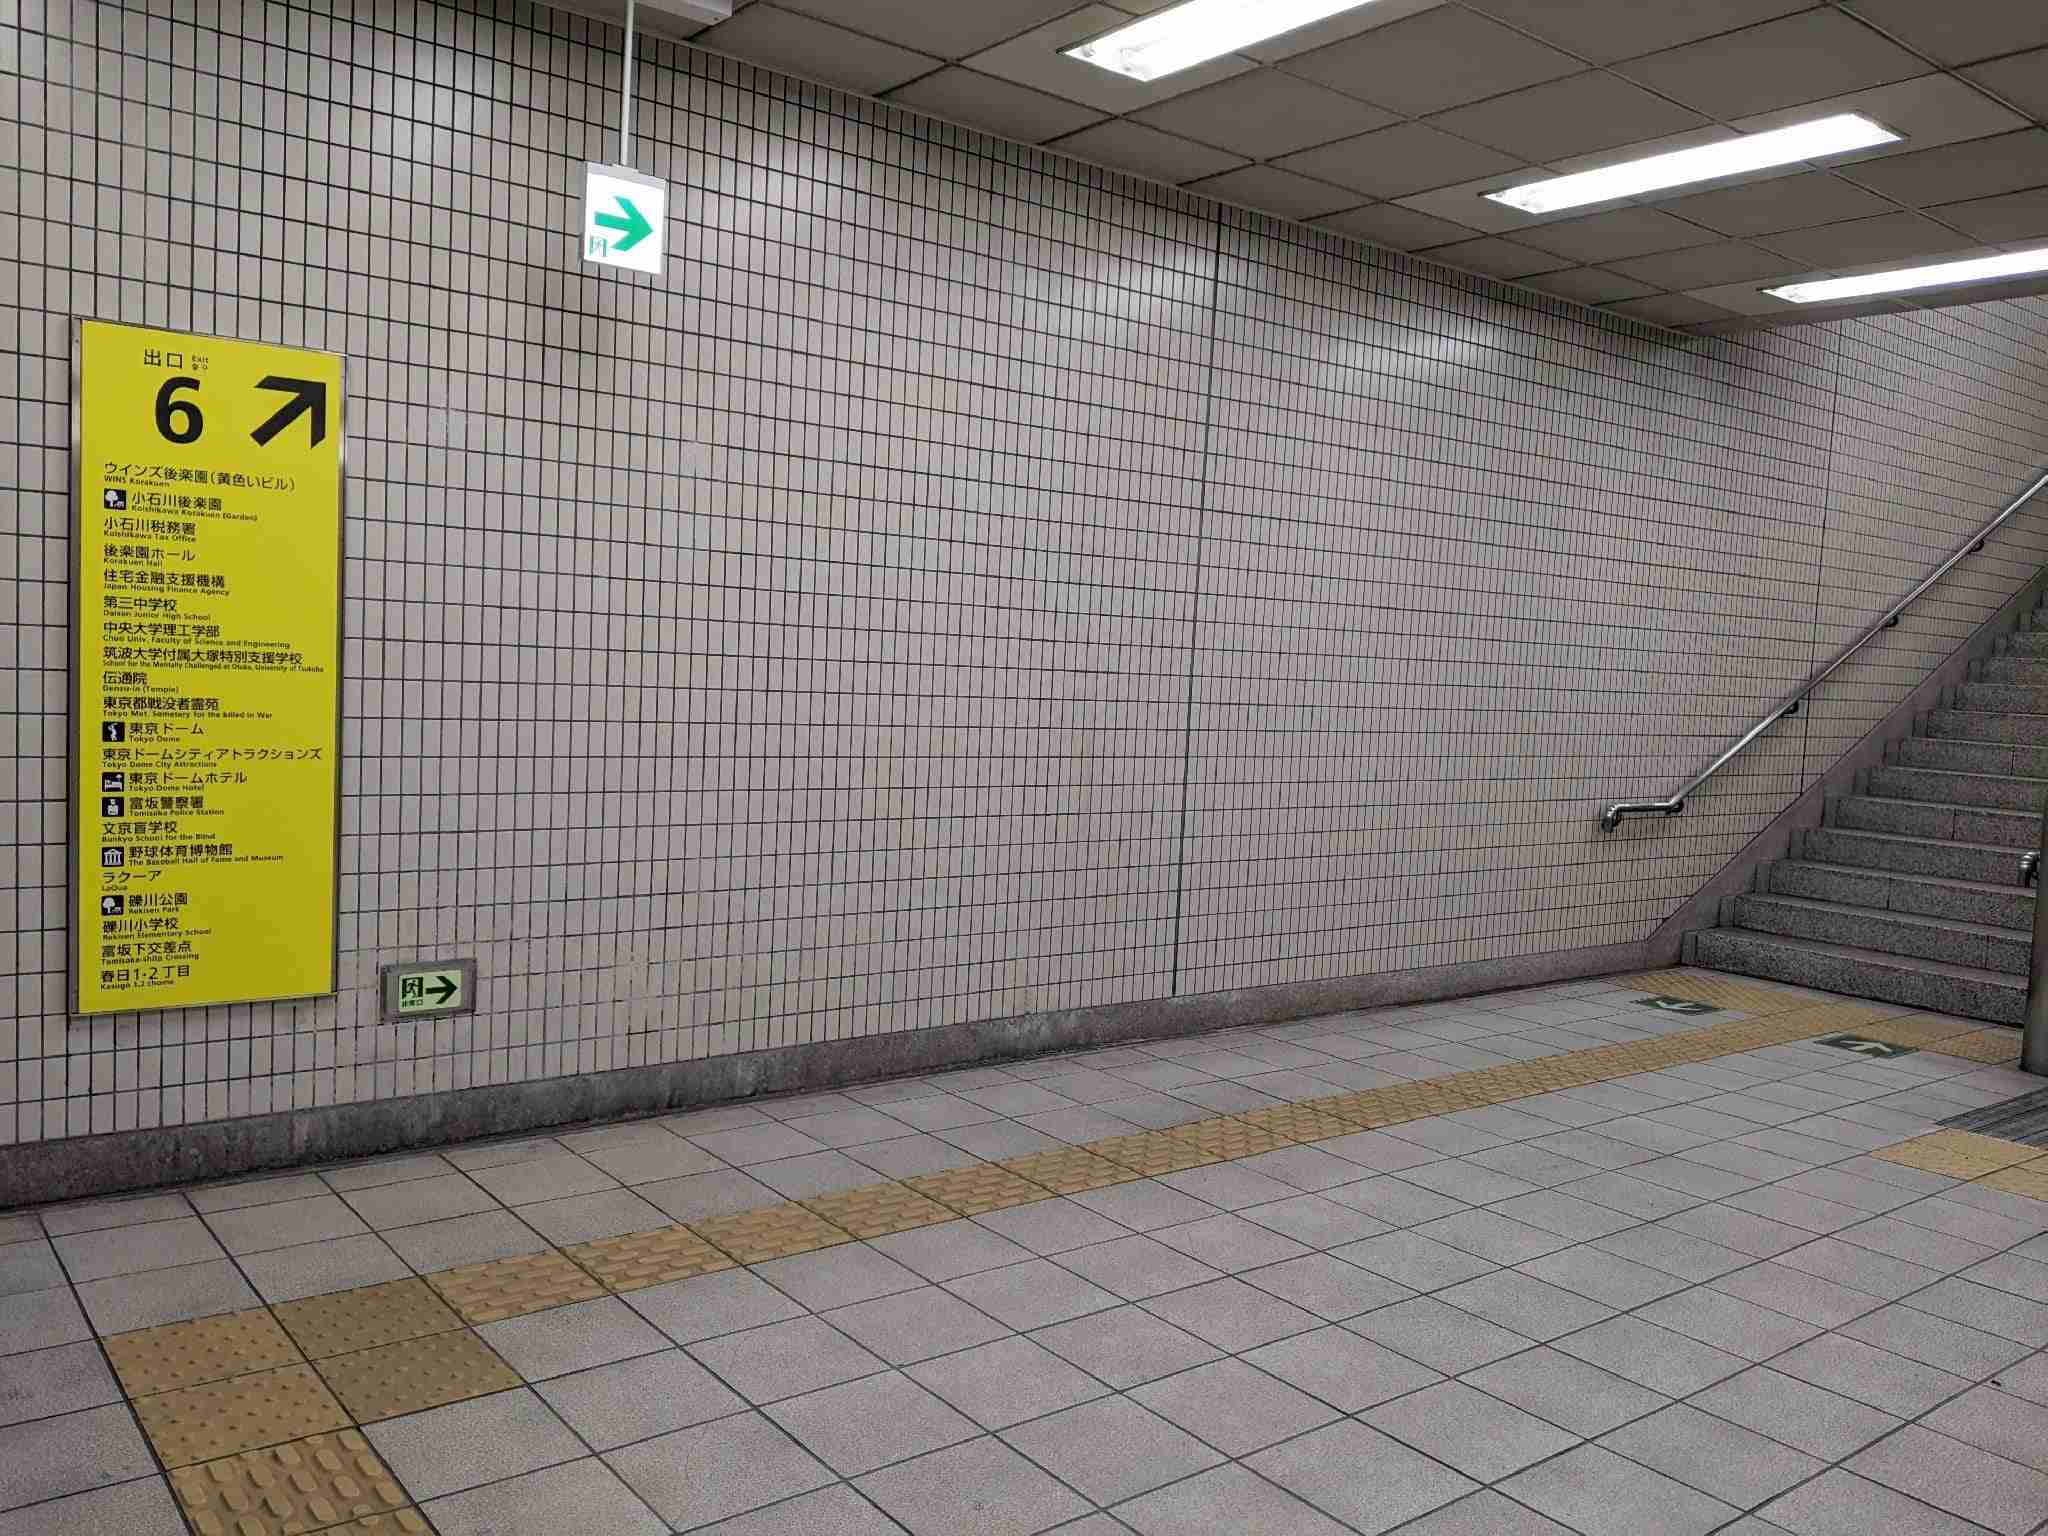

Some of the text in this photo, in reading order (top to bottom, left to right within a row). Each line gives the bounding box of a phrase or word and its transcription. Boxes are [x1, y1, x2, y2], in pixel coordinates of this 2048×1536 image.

[144, 348, 183, 369] 出口
[155, 376, 203, 444] 6
[129, 477, 170, 488] Korakuen
[132, 492, 222, 511] 小石川後楽園
[132, 504, 179, 515] Koishikawa
[182, 507, 220, 518] Korakuen
[104, 516, 196, 535] 小石川税務署
[104, 530, 196, 543] Koishikawa Tax Office
[104, 544, 195, 561] 後楽園ホール
[104, 558, 144, 567] Korakuen
[104, 568, 225, 587] 住宅金融支援機構
[104, 583, 229, 597] Japan Housing Finance Agency
[104, 596, 176, 611] 第三中学校
[162, 612, 182, 621] High
[184, 613, 211, 621] School
[103, 623, 220, 638] 中央大学理工学部
[103, 634, 125, 642] Chuo
[151, 637, 182, 646] Faculty
[194, 638, 225, 647] Science
[227, 639, 241, 647] and
[244, 640, 290, 650] Engineering
[103, 647, 303, 665] 筑波大学付属大塚特別支援学校
[103, 672, 147, 685] 伝通院
[103, 697, 219, 711] 東京都戦没者霊苑
[102, 710, 128, 718] Tokyo
[130, 723, 204, 735] 東京ドーム
[130, 736, 154, 744] Tokyo
[103, 748, 321, 761] 東京ドームシティアトラクションズ
[157, 760, 173, 768] City
[130, 772, 247, 784] 東京ドームホテル
[130, 784, 154, 792] Tokyo
[156, 784, 180, 792] Dome
[129, 796, 203, 809] 富坂警察署
[102, 821, 177, 835] 文京盲学校
[102, 835, 133, 843] Bunkyo
[129, 844, 232, 858] 野球体育博物館
[129, 858, 145, 866] The
[147, 857, 180, 866] Baseball
[183, 856, 198, 864] Hall
[103, 870, 161, 883] ラクーア
[128, 893, 187, 908] 礫川公園
[103, 918, 178, 933] 礫川小学校
[137, 930, 182, 939] Elementary
[102, 941, 192, 958] 富坂下交差点
[166, 952, 199, 961] Crossing
